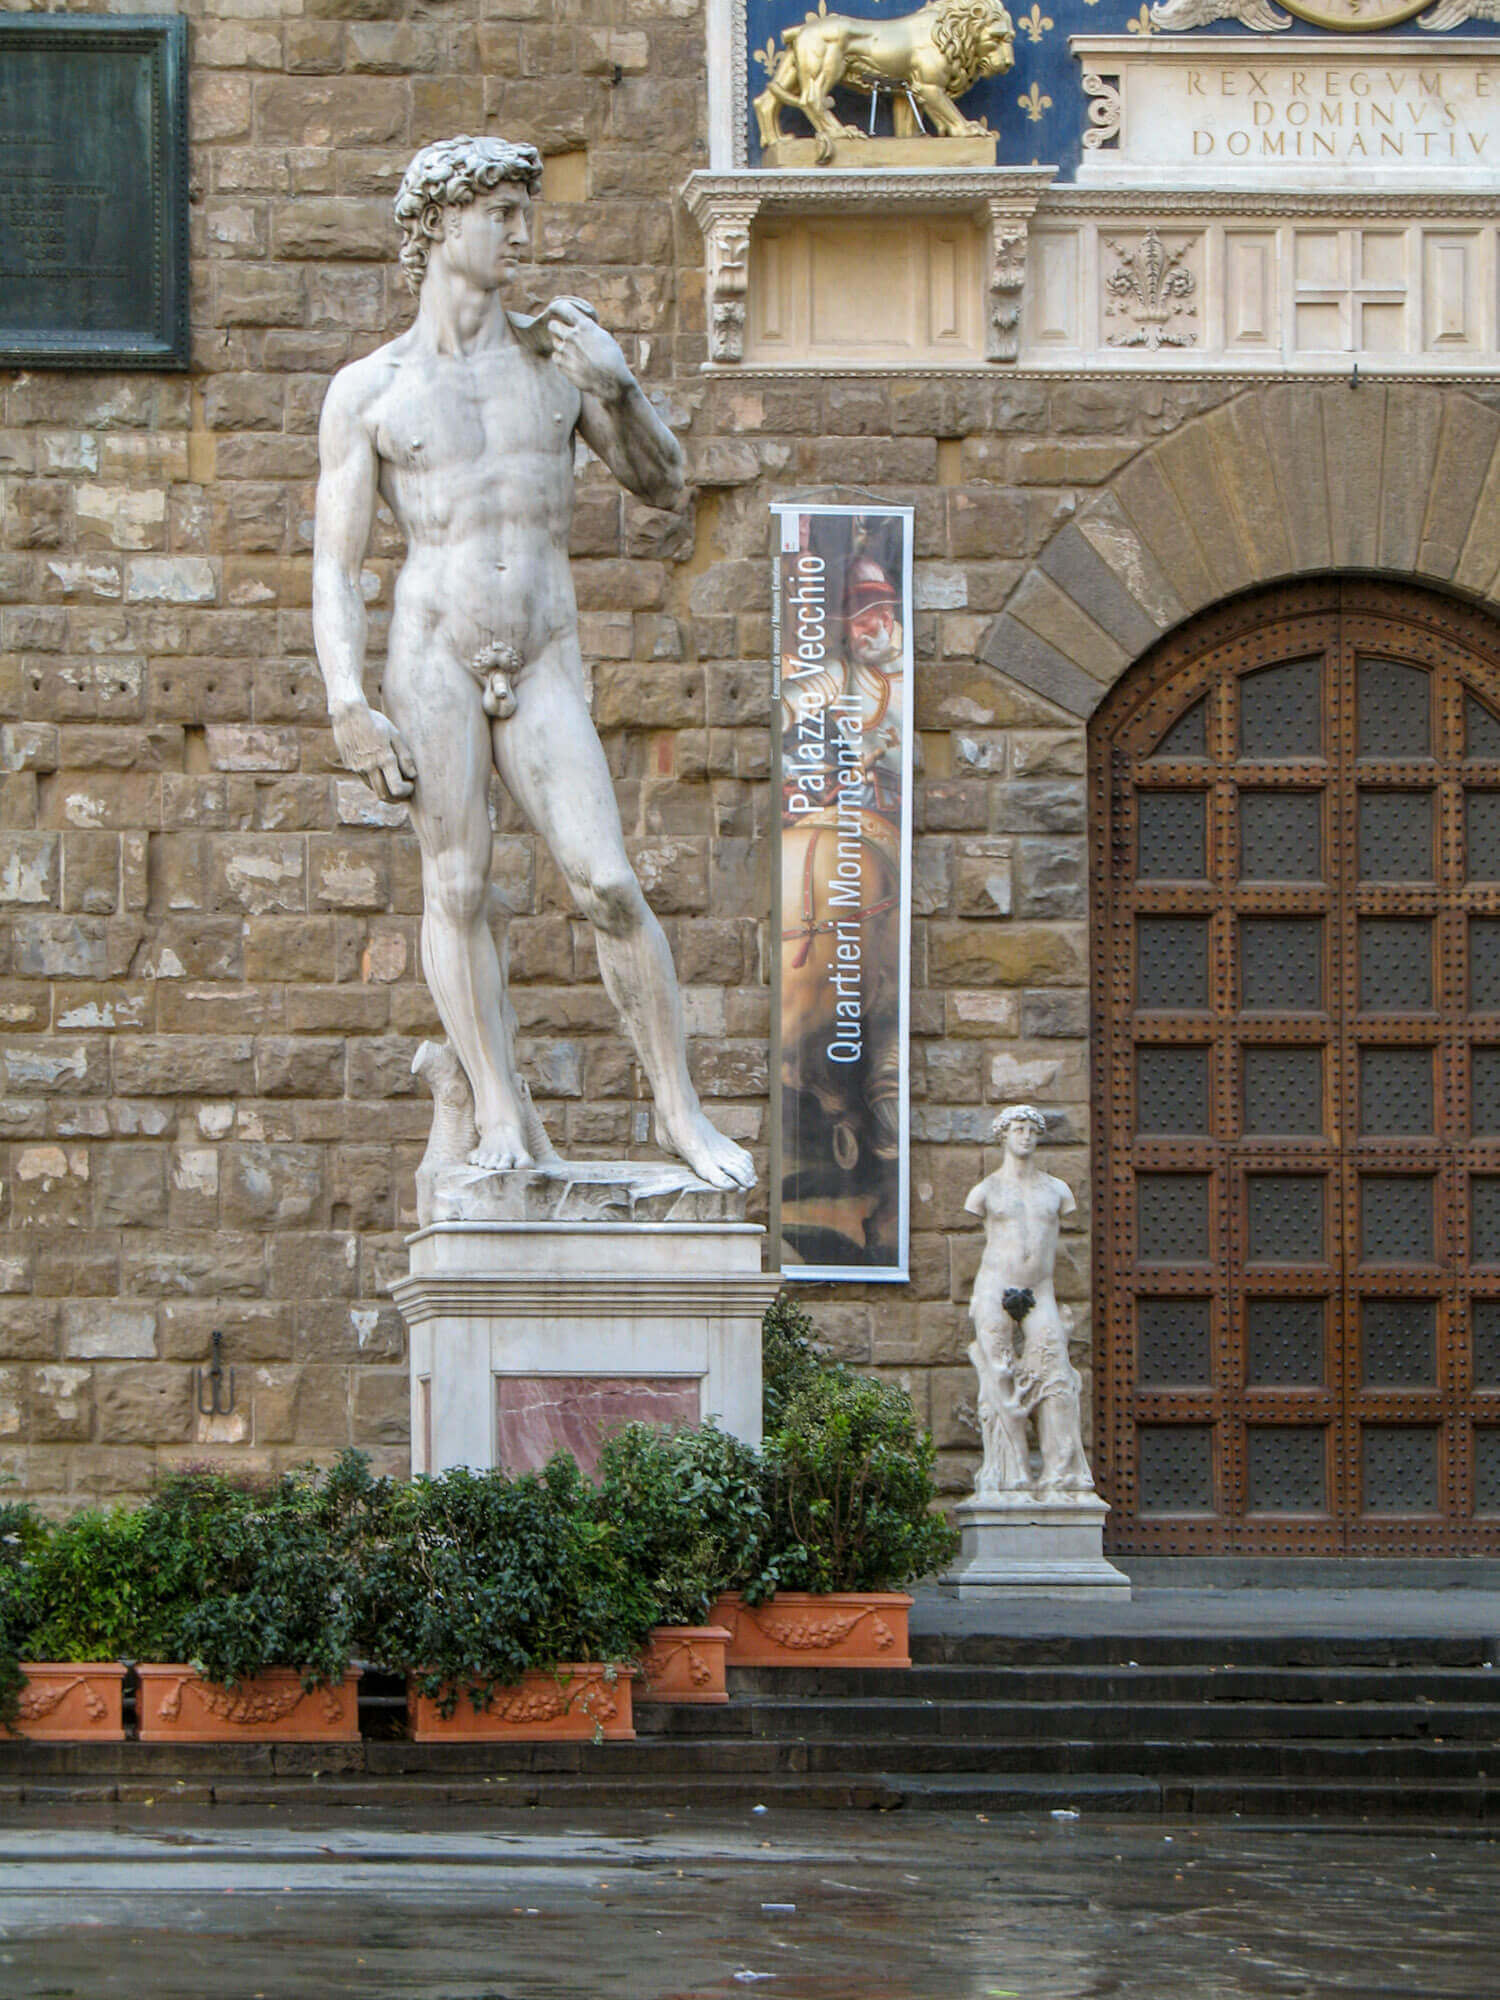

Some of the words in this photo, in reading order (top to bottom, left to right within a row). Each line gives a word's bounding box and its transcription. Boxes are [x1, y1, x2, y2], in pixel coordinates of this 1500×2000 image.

[1186, 71, 1269, 96] REX
[1291, 71, 1442, 97] REGVM
[1253, 101, 1458, 127] DOMINVS
[788, 556, 826, 680] Vecchio
[788, 691, 825, 813] Palazzo
[828, 694, 863, 907] Monumentali
[826, 921, 863, 1064] Quartieri
